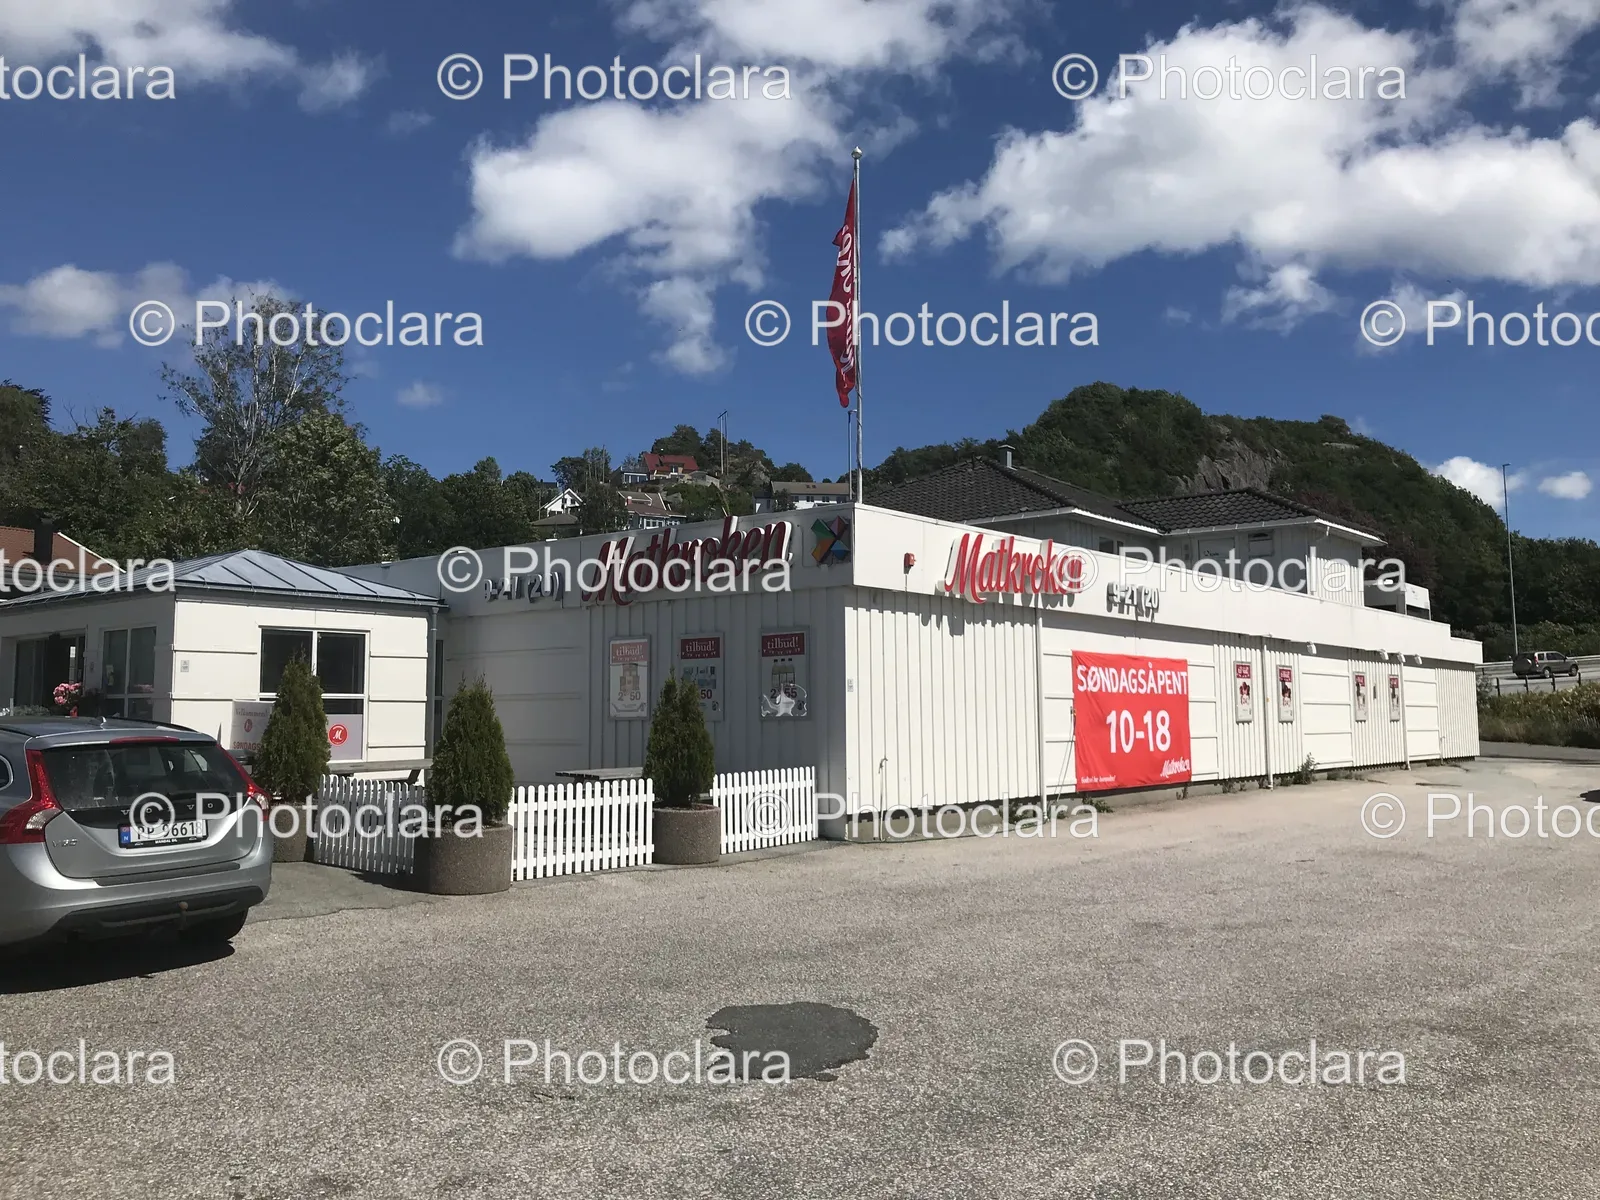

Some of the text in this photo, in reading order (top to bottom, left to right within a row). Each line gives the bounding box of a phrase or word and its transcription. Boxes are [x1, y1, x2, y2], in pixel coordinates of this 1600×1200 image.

[685, 640, 715, 652] tilbud!
[766, 636, 799, 649] tilbud!
[616, 645, 643, 657] tilbud!
[1076, 662, 1188, 695] SØNDAGSÅPENT
[617, 691, 641, 701] 2 50
[700, 689, 713, 699] 50
[1106, 709, 1170, 754] 10-18
